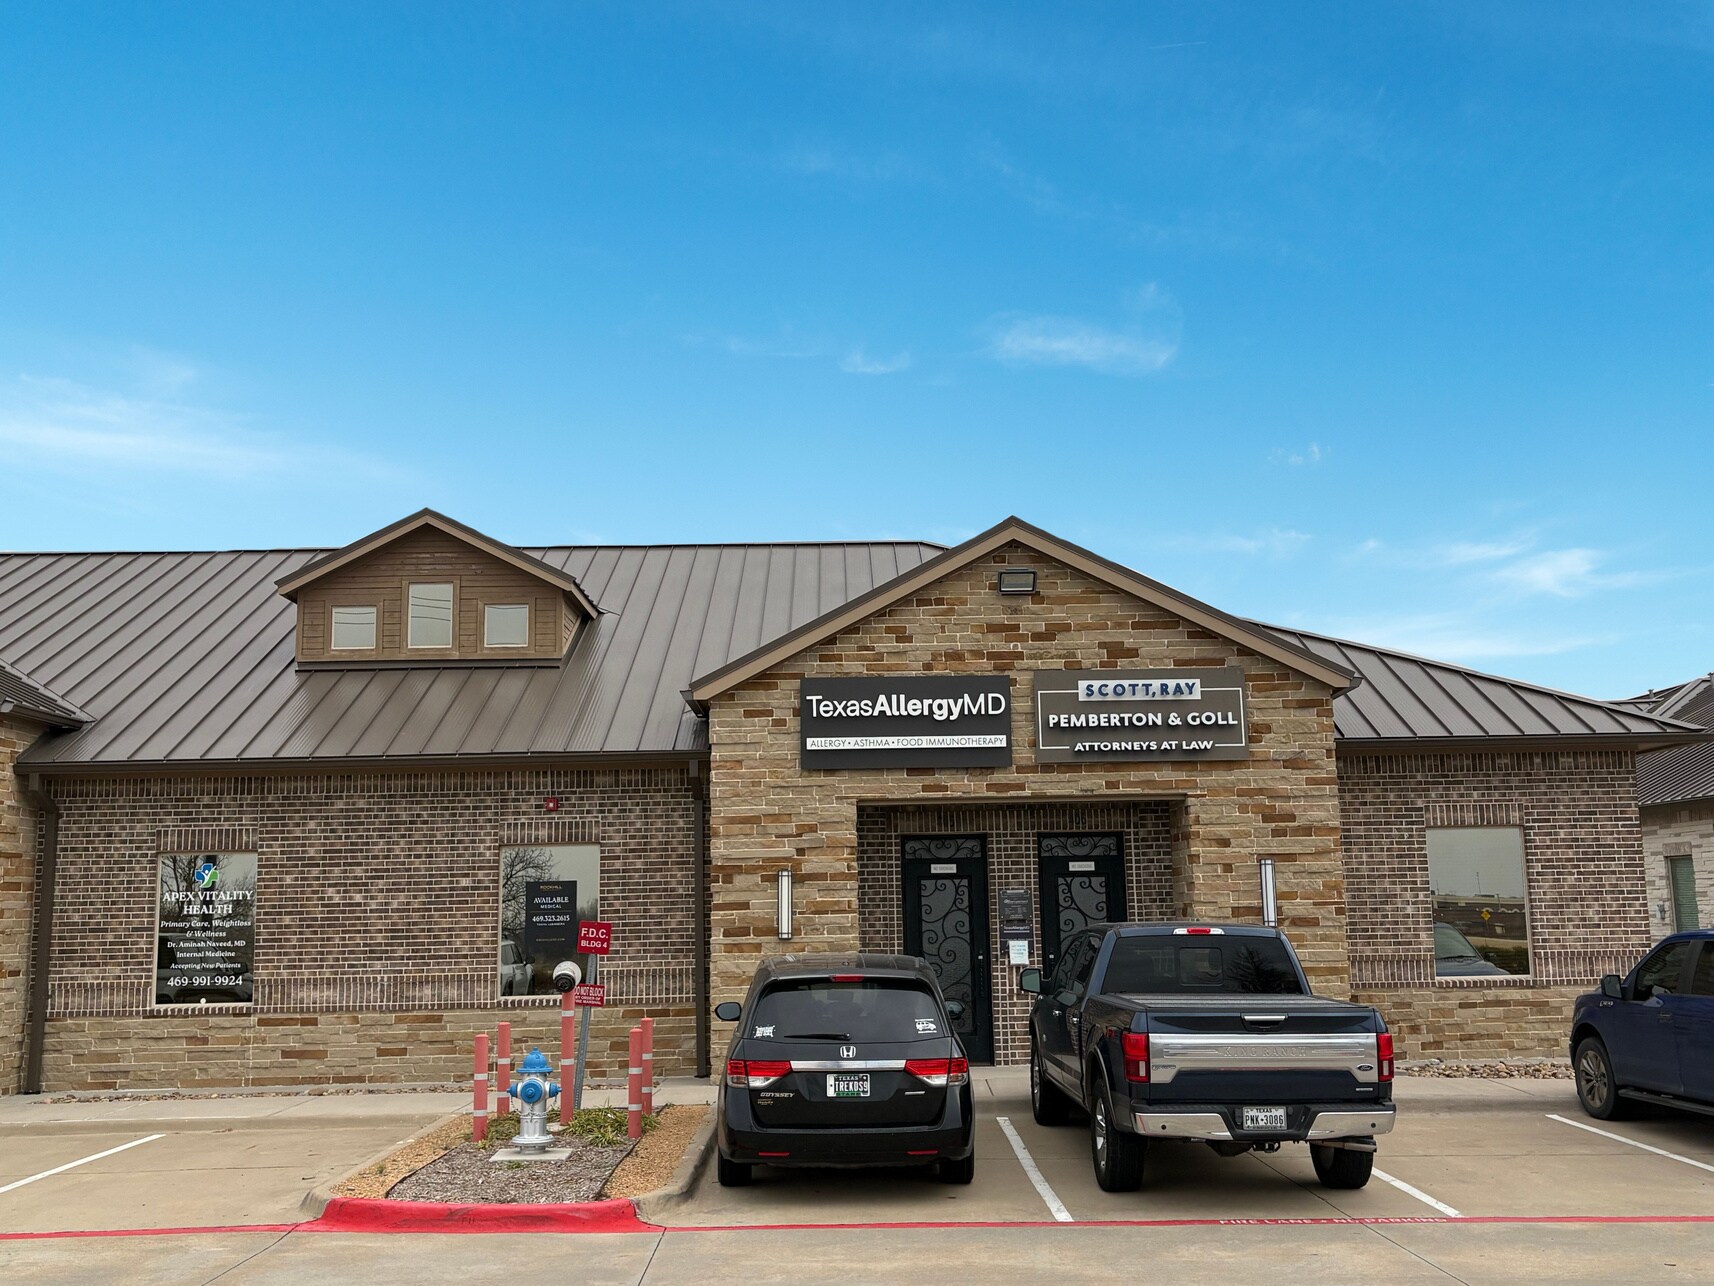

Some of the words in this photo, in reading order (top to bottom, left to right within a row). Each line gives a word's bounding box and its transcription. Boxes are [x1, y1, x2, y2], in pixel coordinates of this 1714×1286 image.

[805, 692, 1006, 721] TexasAllergyMD
[1049, 712, 1162, 727] PEMBERTON
[1168, 713, 1182, 725] &
[1187, 712, 1238, 725] GOLL
[810, 738, 846, 748] ALLERGY
[853, 738, 890, 748] ASTHMA
[896, 737, 924, 747] FOOD
[925, 736, 1004, 747] IMMUNOTHERAPY
[1074, 741, 1157, 751] ATTORNEYS
[1160, 741, 1178, 750] AT
[1182, 740, 1213, 749] LAW
[163, 892, 195, 901] APEX
[198, 891, 253, 900] VITALITY
[184, 905, 232, 914] HEALTH
[581, 929, 608, 938] F.D.C.
[603, 940, 607, 948] 4
[167, 976, 243, 986] 469-991-9924
[581, 987, 589, 995] NOT
[590, 987, 603, 997] BLOCK
[1224, 1047, 1257, 1057] KING
[1263, 1047, 1306, 1057] RANCH
